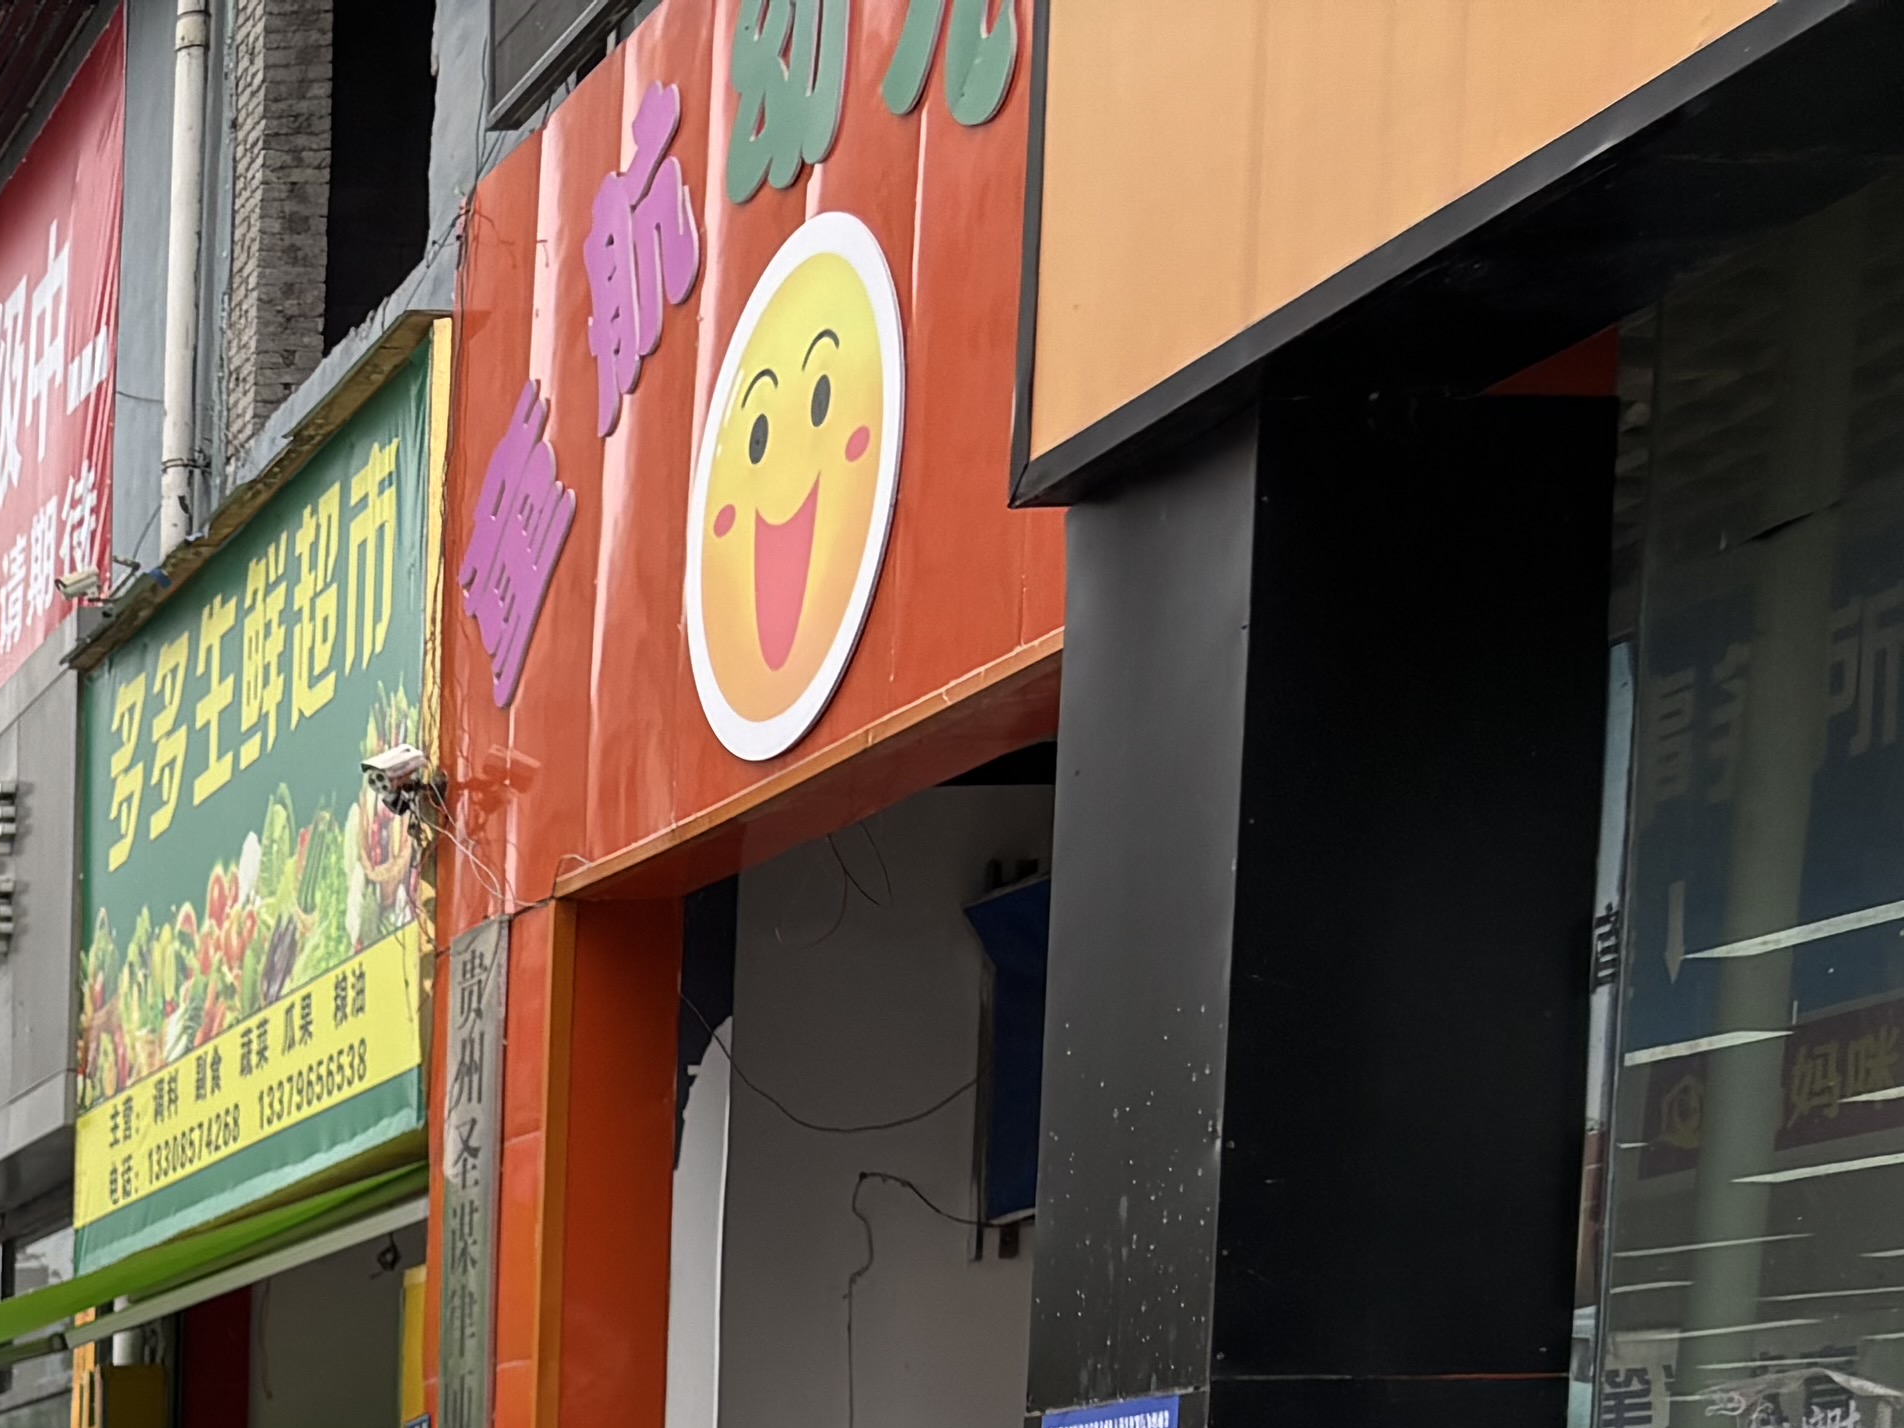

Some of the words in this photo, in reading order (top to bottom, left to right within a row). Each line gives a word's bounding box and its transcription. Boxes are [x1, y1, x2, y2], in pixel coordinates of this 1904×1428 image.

[108, 438, 400, 873] 多多生鲜超市
[239, 1016, 270, 1078] 蔬菜
[281, 991, 314, 1057] 瓜果
[147, 1103, 241, 1185] 13308574268
[257, 1037, 368, 1131] 13379656538
